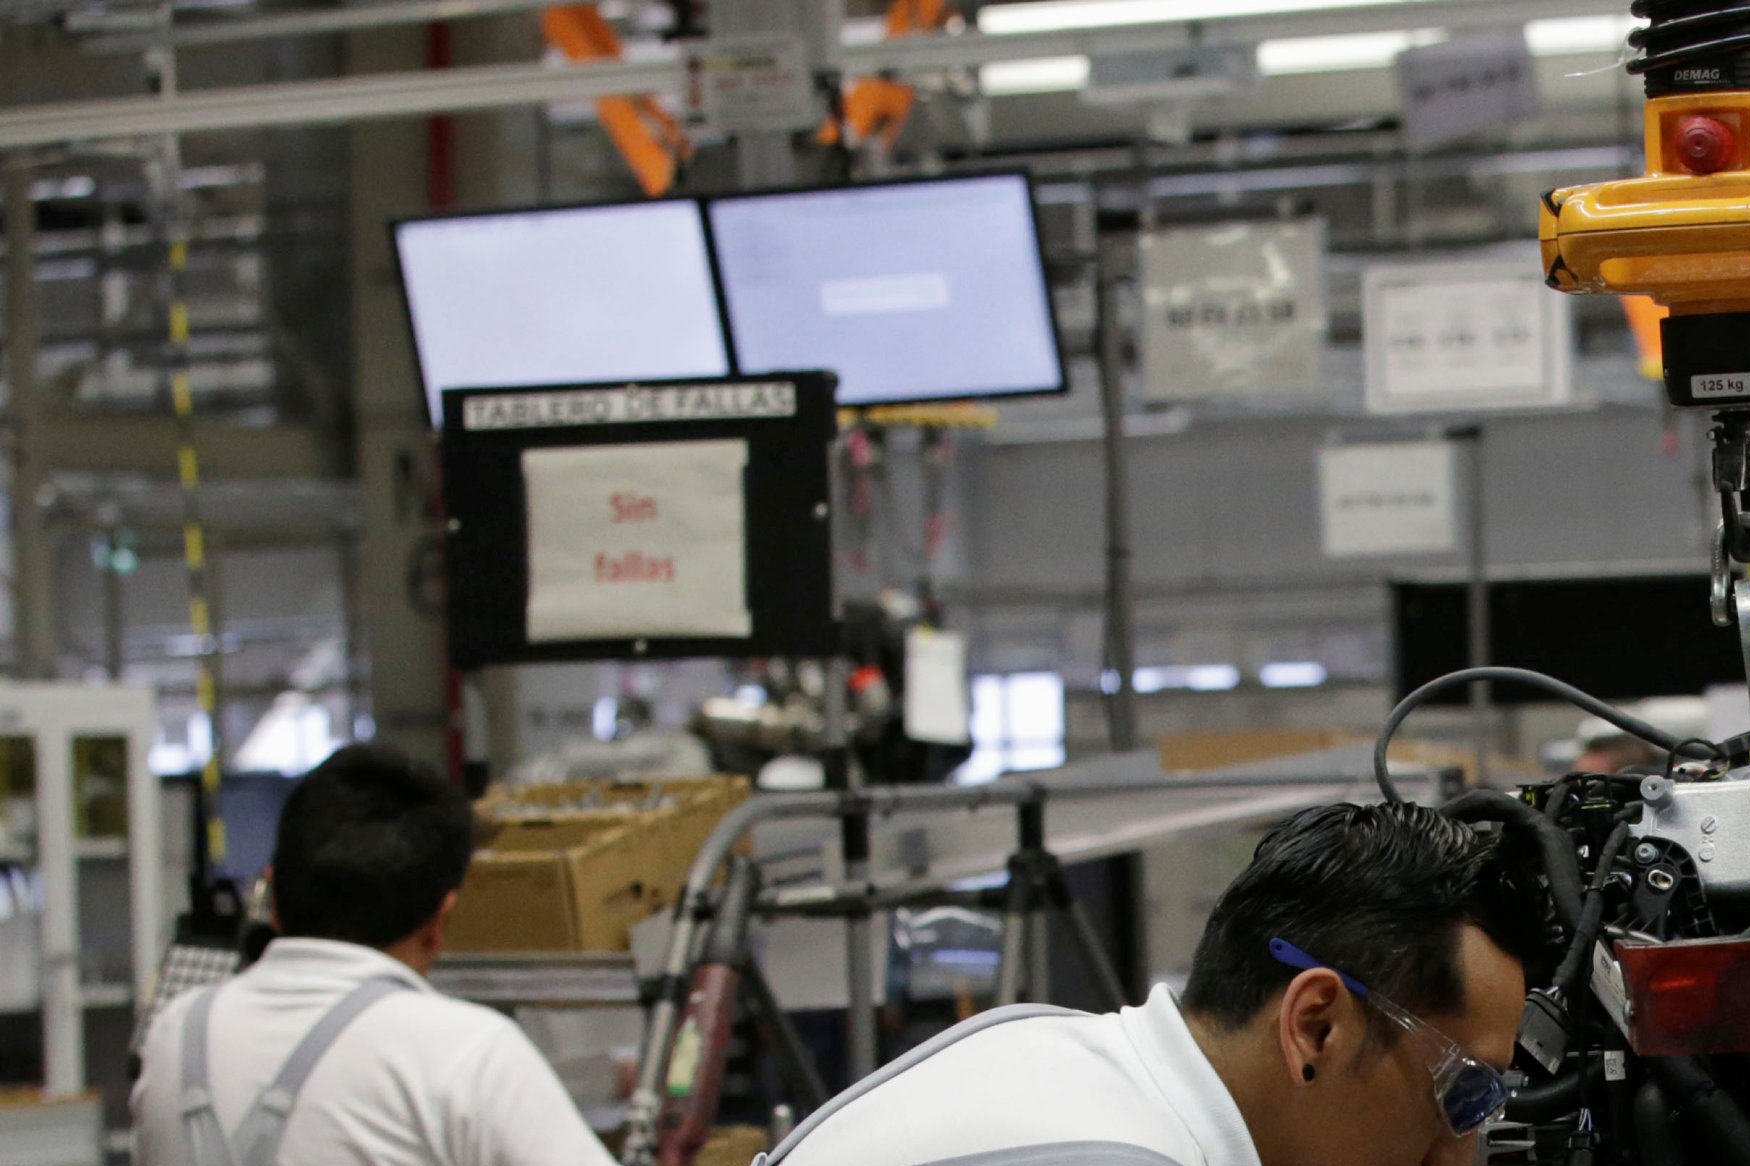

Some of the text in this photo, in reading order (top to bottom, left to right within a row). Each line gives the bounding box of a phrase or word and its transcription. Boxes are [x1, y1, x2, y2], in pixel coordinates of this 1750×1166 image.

[1674, 69, 1720, 81] DEMAG
[1701, 379, 1744, 392] 125 kg
[472, 384, 791, 426] TABLERO DE FALLAS
[609, 491, 657, 524] Sin
[594, 550, 677, 583] fallas
